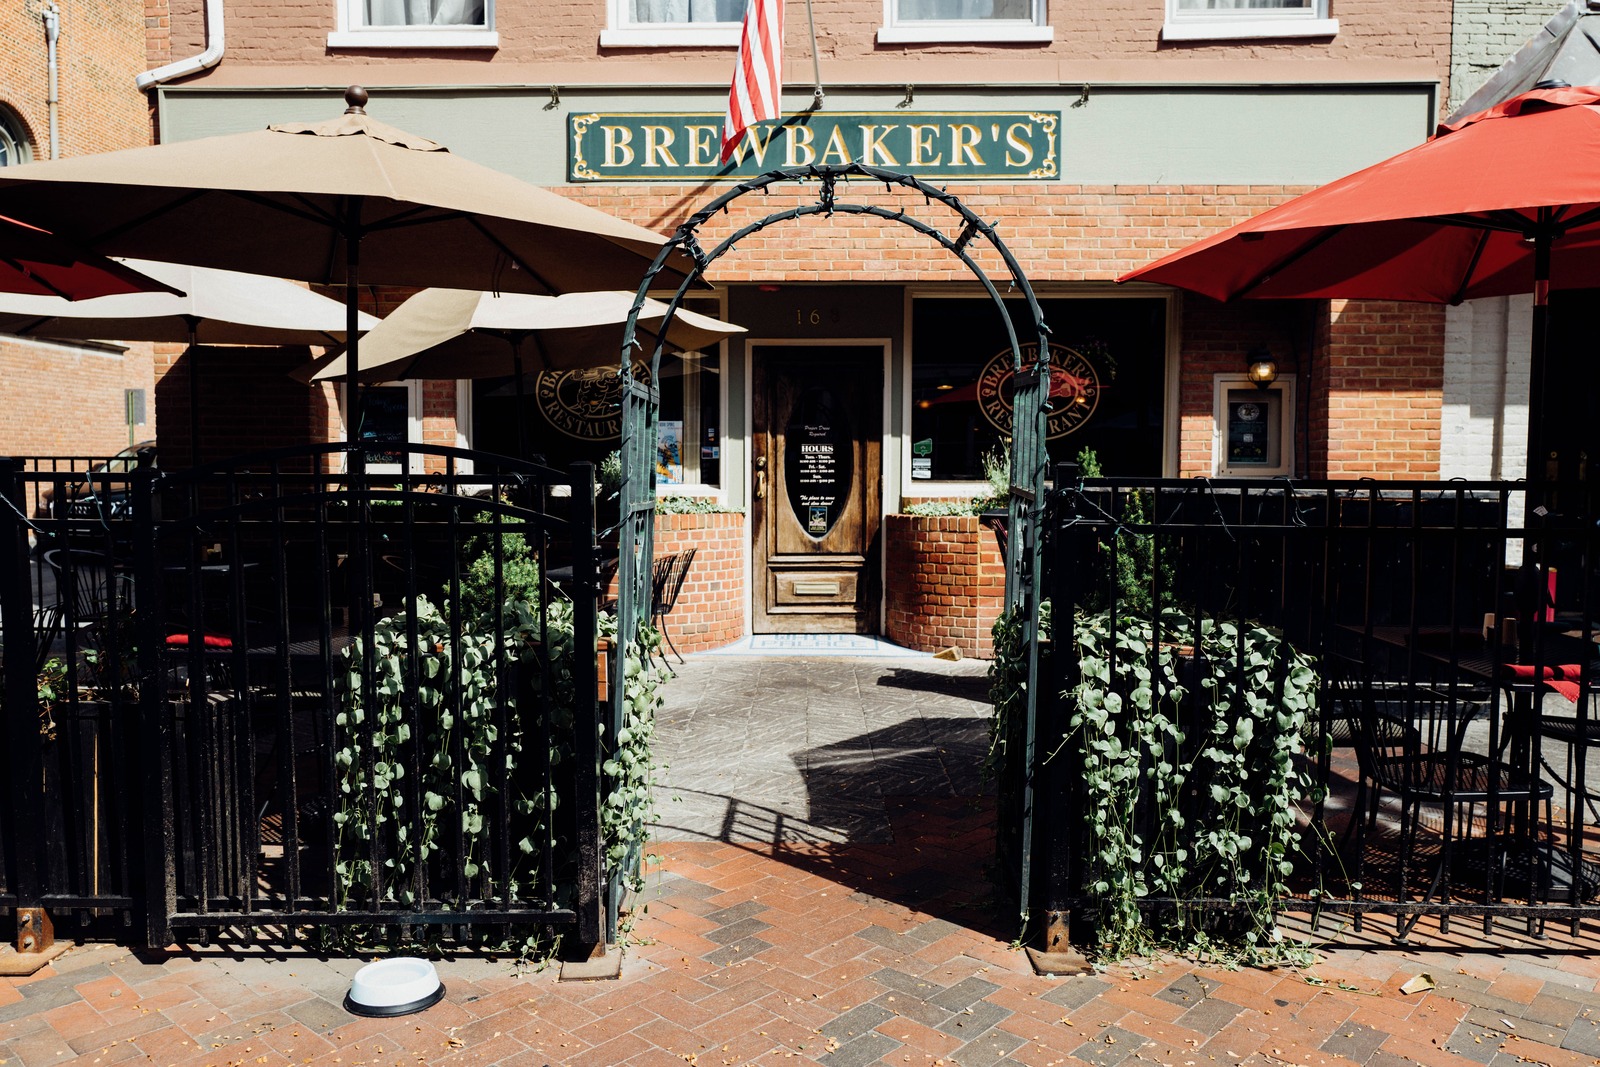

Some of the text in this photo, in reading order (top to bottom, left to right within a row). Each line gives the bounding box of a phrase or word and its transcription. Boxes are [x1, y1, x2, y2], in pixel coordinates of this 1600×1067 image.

[599, 121, 1034, 168] BREWBAKER'S
[545, 401, 624, 437] RESTAUR
[985, 400, 1092, 435] RESRANT
